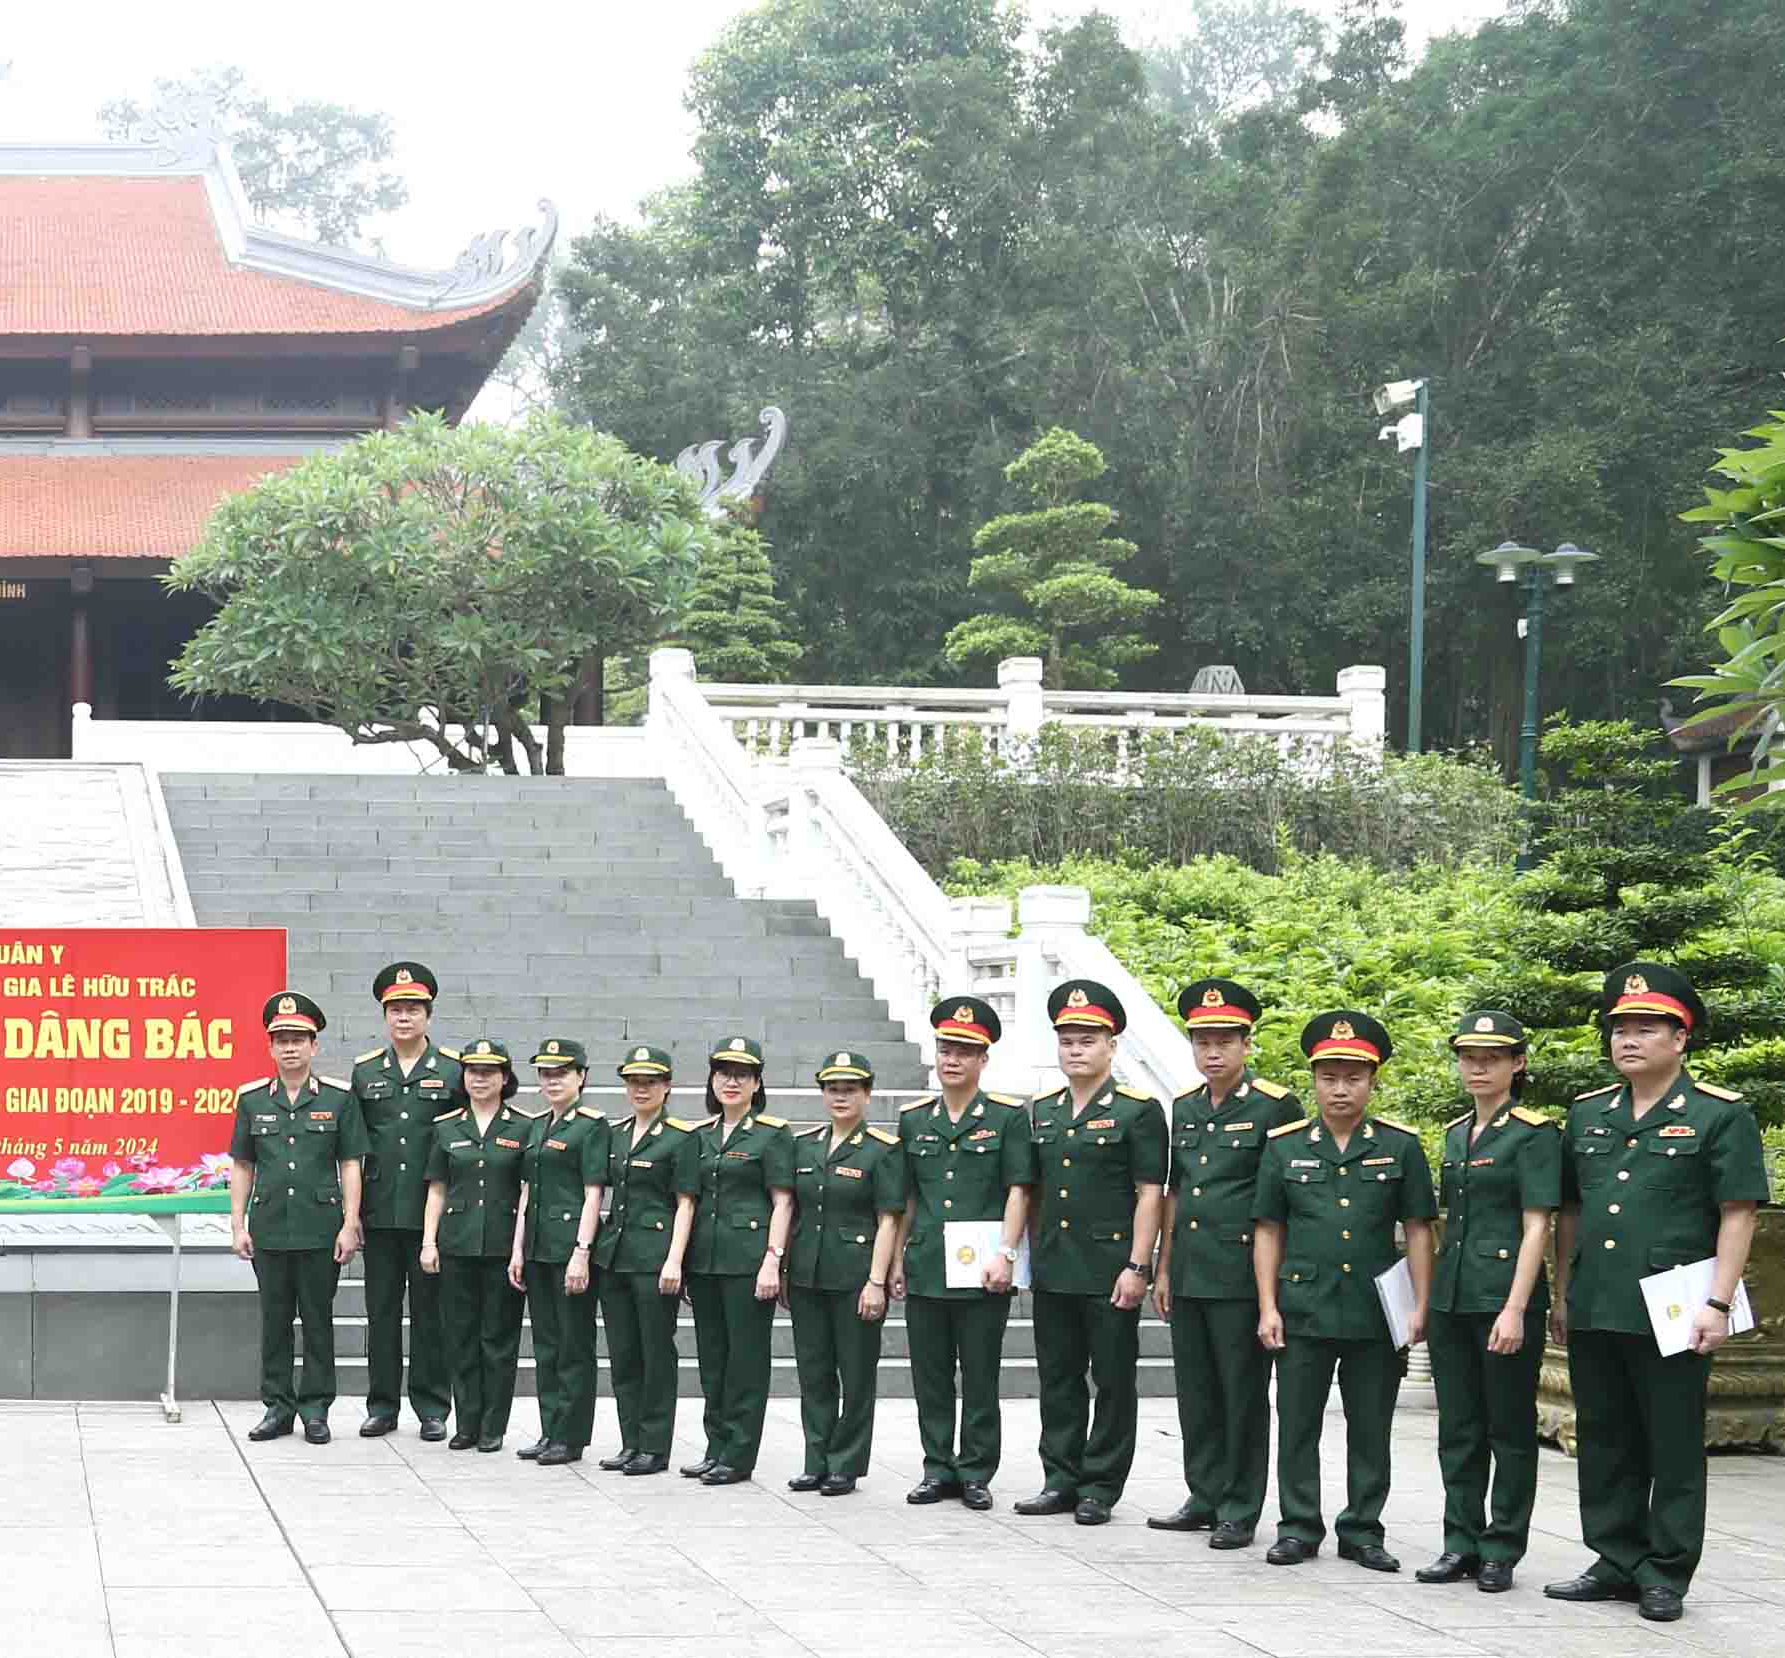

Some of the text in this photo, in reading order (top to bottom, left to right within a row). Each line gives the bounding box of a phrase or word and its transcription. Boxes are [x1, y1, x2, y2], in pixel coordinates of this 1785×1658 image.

[50, 944, 64, 965] Y
[3, 976, 43, 997] GIA
[49, 974, 75, 997] LÊ
[83, 974, 130, 997] HỮU
[136, 974, 197, 998] TRÁC
[4, 1010, 131, 1059] DÂNG
[144, 1010, 233, 1059] BÁC
[6, 1087, 49, 1113] GIAI
[55, 1087, 114, 1119] ĐOẠN
[120, 1087, 173, 1114] 2019
[52, 1138, 64, 1155] 5
[68, 1139, 108, 1156] năm
[114, 1138, 159, 1156] 2024
